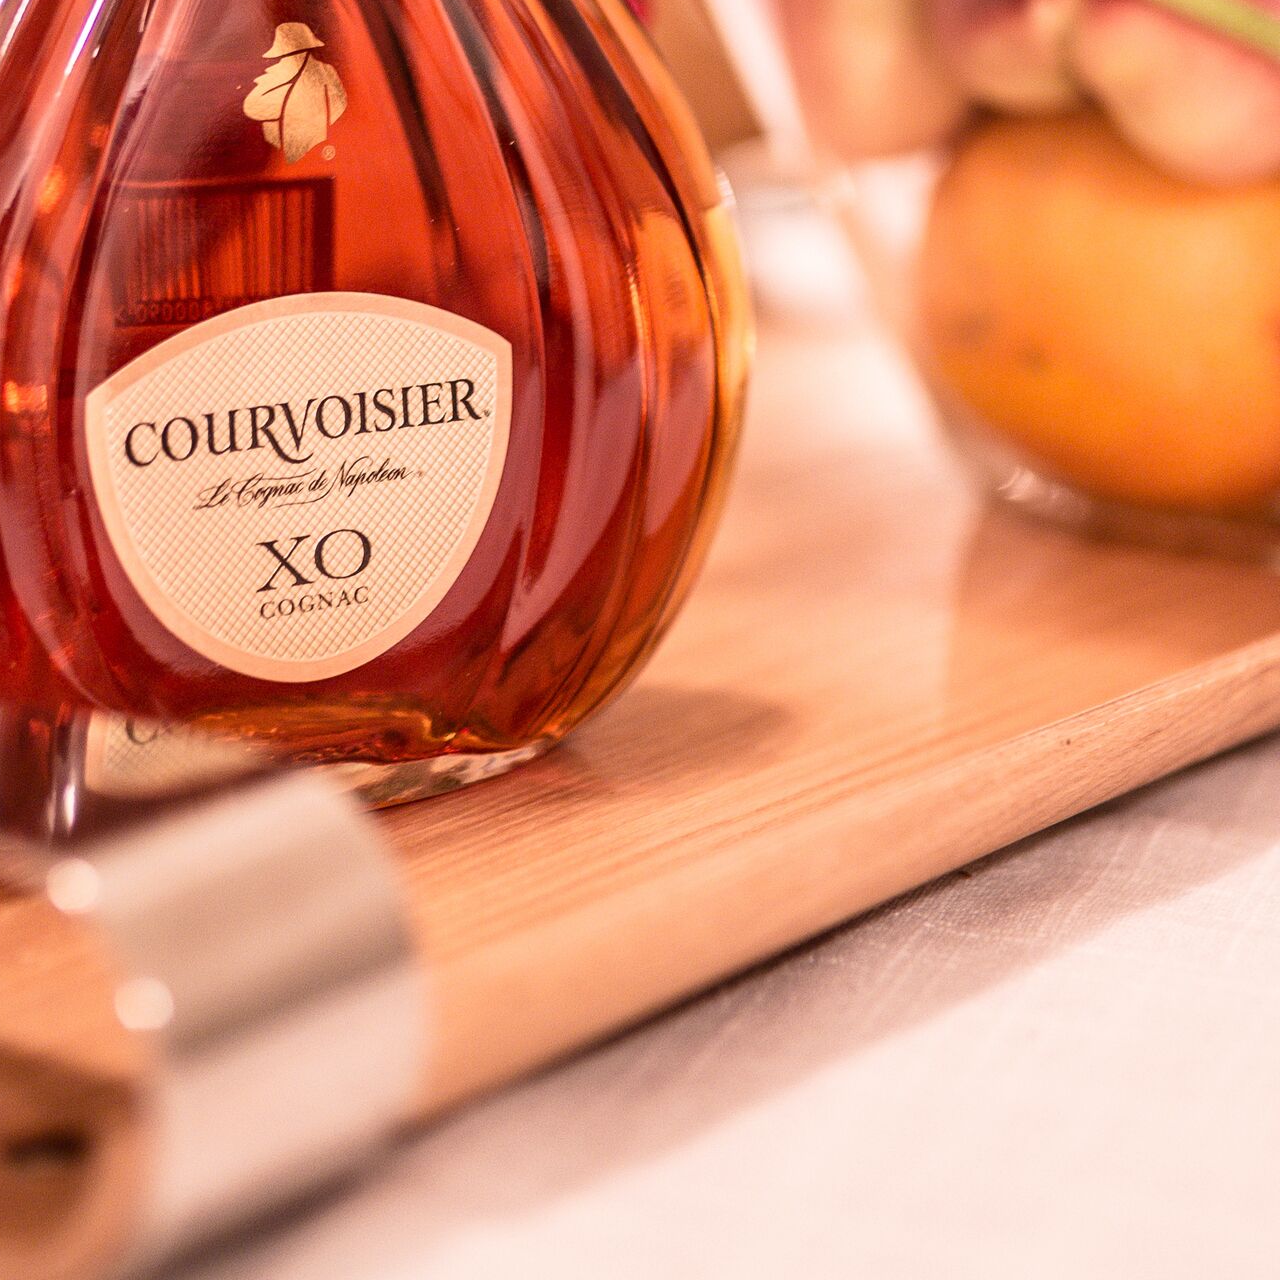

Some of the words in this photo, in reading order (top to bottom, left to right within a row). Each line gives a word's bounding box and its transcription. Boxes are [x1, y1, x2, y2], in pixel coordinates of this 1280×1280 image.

[124, 378, 483, 467] COURVOISIER
[194, 478, 230, 510] Le
[231, 471, 310, 509] Cognac
[308, 470, 327, 490] de
[314, 455, 413, 503] Napoleon
[256, 529, 372, 593] XO
[260, 586, 369, 620] COGNAC
